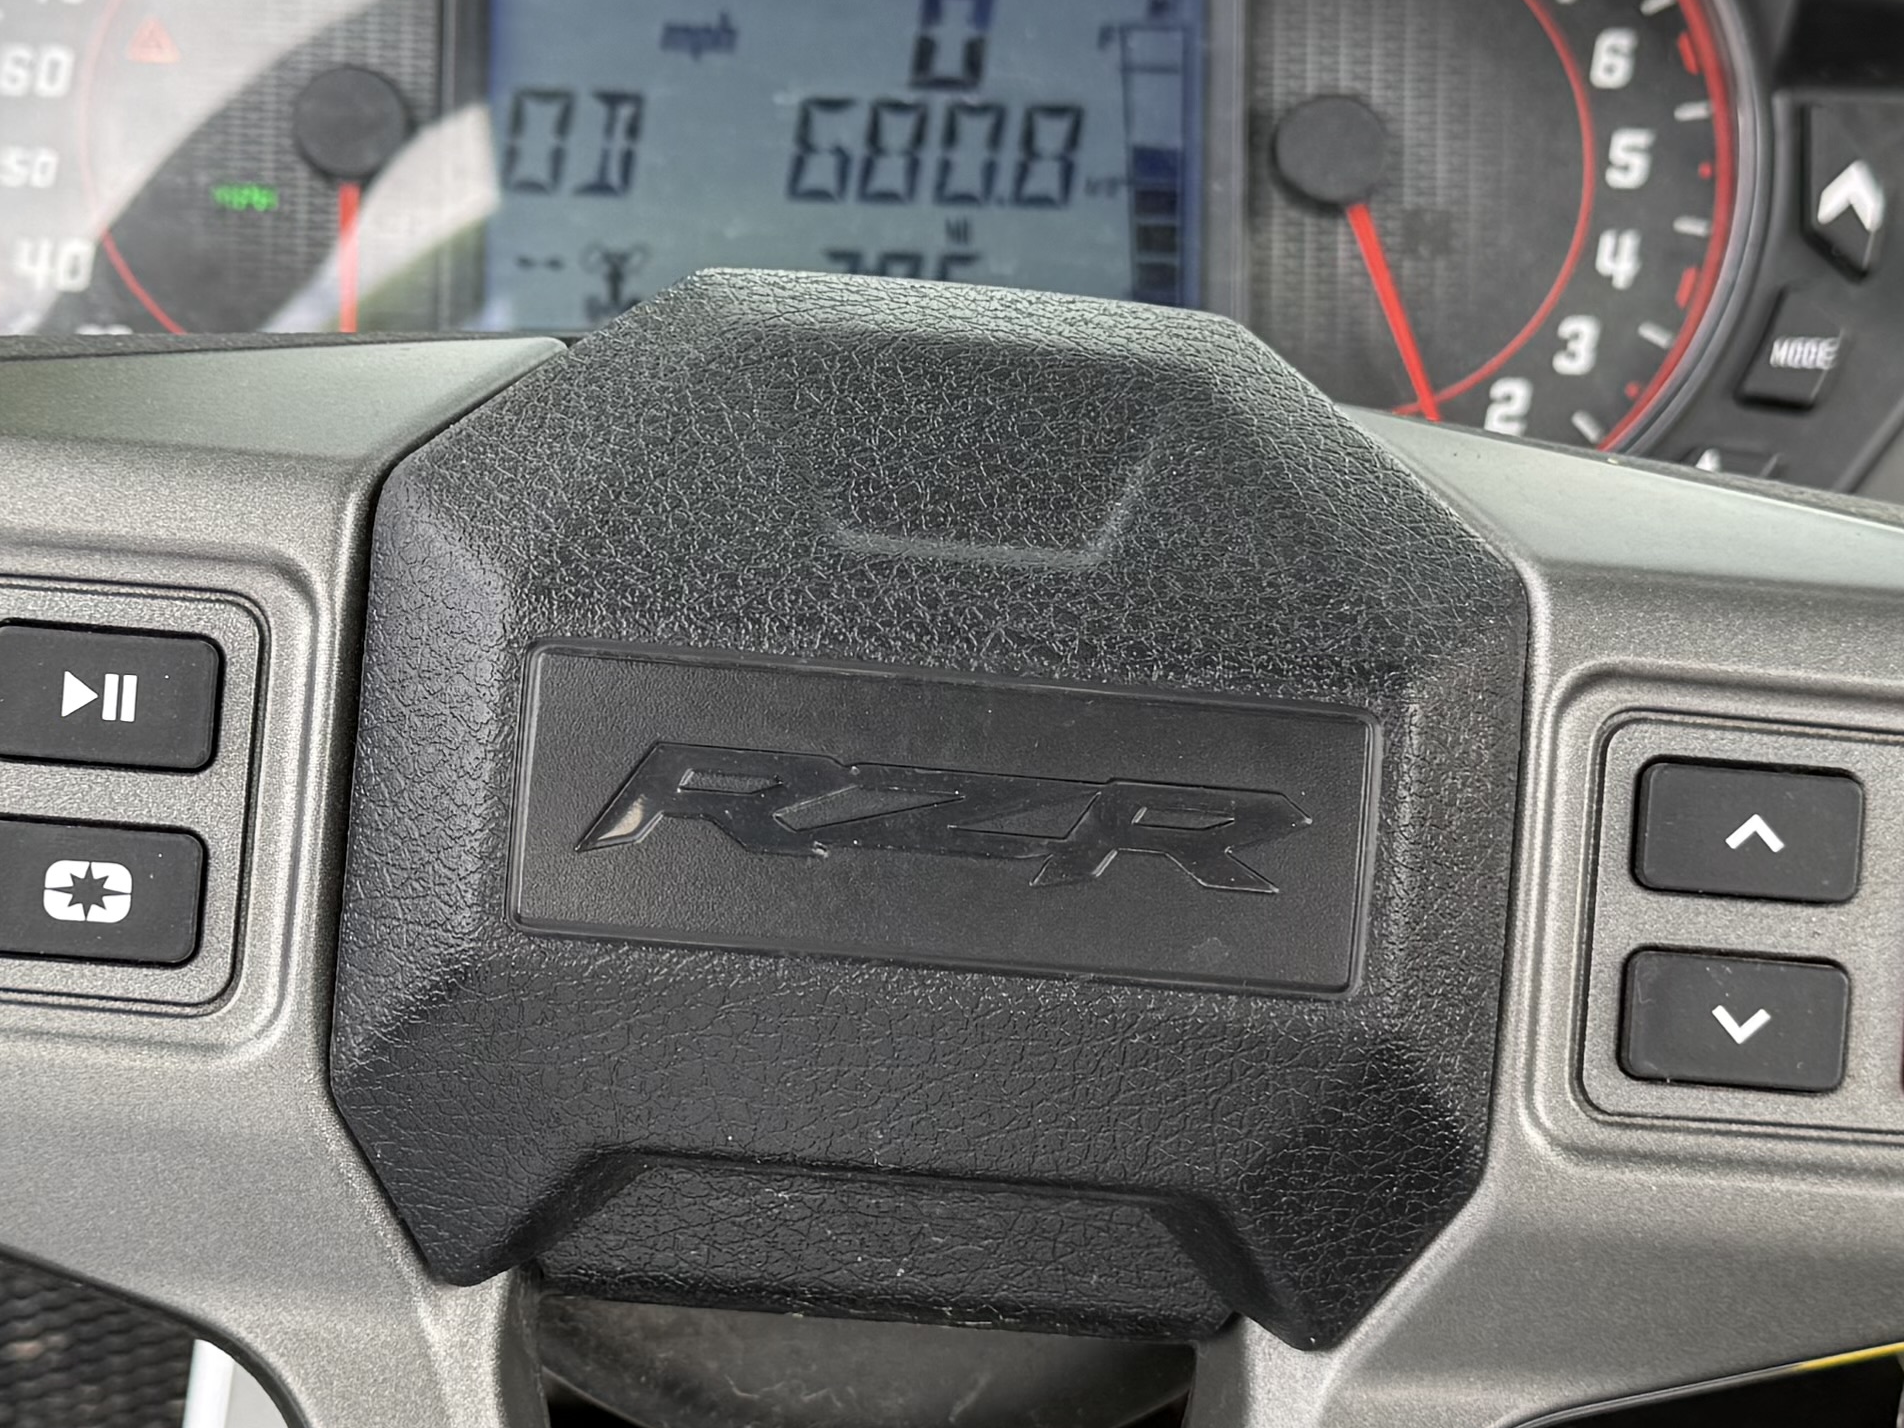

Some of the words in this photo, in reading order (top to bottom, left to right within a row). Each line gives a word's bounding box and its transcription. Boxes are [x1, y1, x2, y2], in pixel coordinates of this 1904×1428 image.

[658, 12, 740, 62] mph
[1590, 28, 1638, 89] 6
[786, 96, 1086, 210] 680.8
[1606, 127, 1657, 190] 5
[13, 237, 94, 293] 40
[1595, 229, 1643, 289] 4
[1553, 315, 1601, 374] 3
[1769, 335, 1841, 372] MODE
[1485, 377, 1533, 437] 2
[573, 739, 1315, 896] RZR
